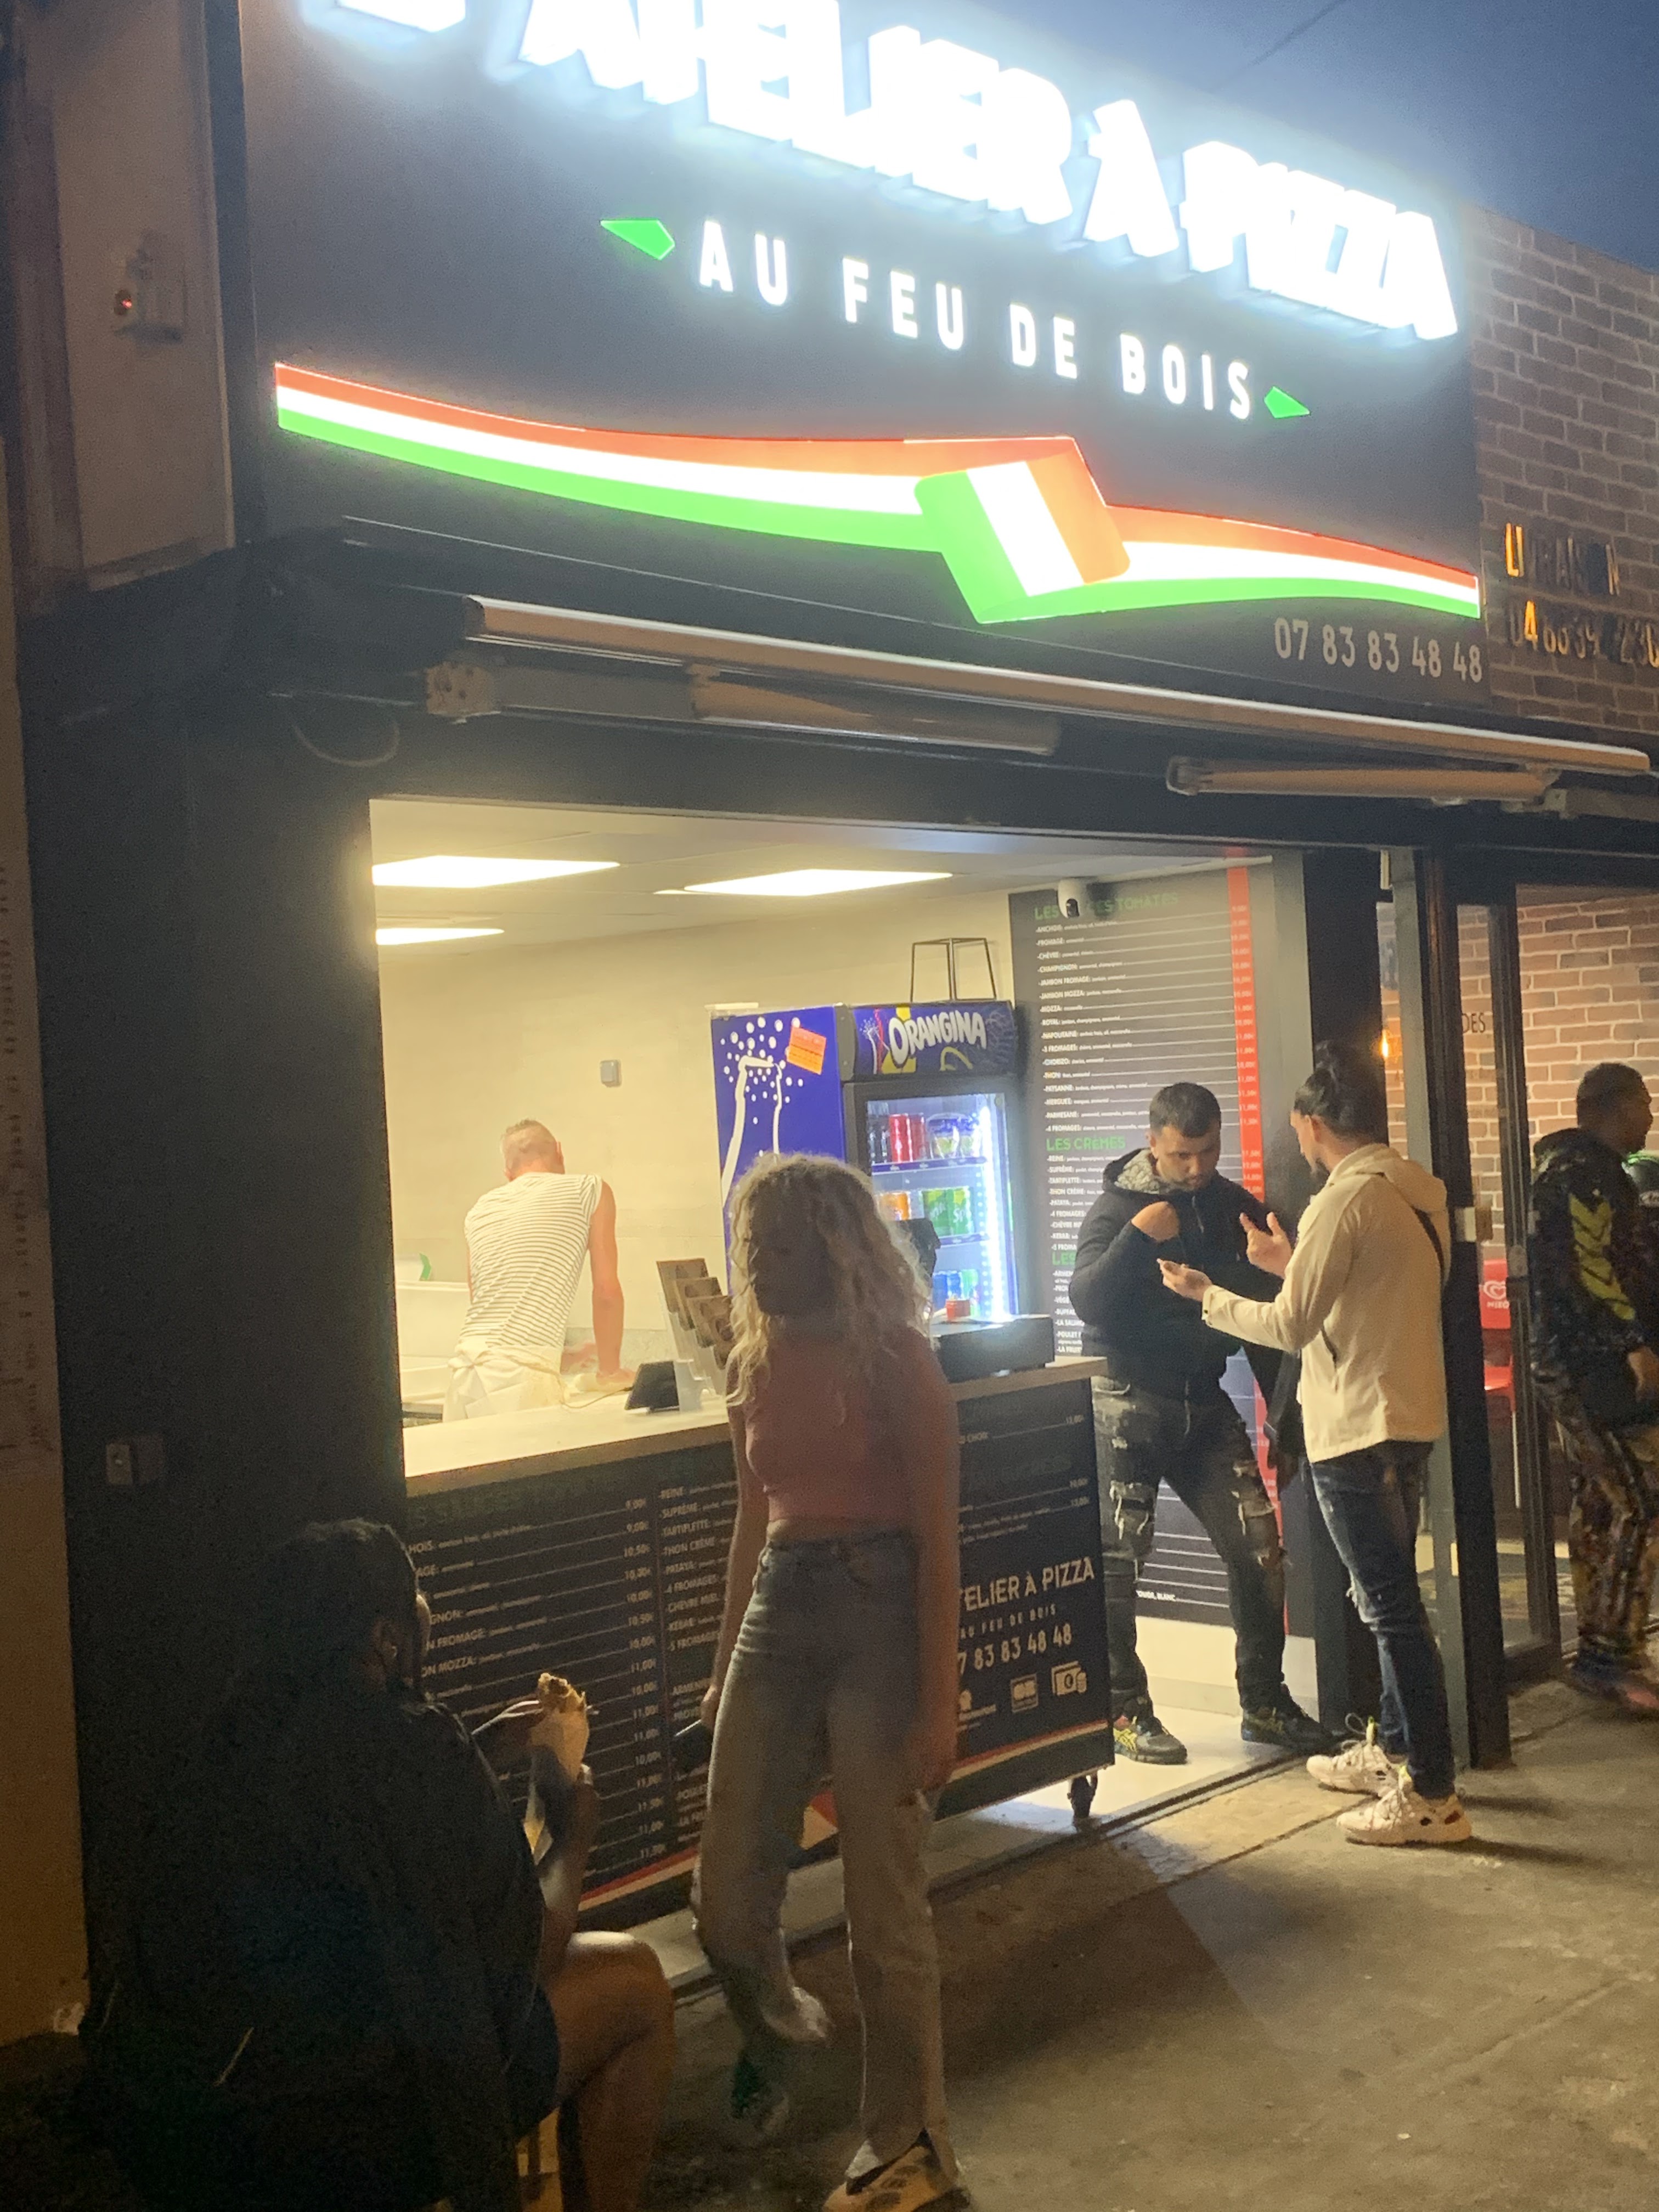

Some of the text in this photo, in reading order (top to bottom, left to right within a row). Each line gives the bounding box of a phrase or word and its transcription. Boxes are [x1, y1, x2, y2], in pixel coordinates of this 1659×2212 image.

[1180, 141, 1458, 340] PIZZA
[699, 219, 1251, 420] AU FEU DE BOIS
[1274, 617, 1482, 683] 07 83 83 48 48
[889, 1010, 987, 1065] ORANGINA
[1046, 1138, 1070, 1151] LES
[960, 1575, 1019, 1611] ELIER
[1042, 1556, 1094, 1591] PIZZA
[981, 1617, 1003, 1634] FEU
[1030, 1603, 1056, 1622] BOIS
[974, 1644, 995, 1671] 83
[1001, 1636, 1022, 1663] 83
[1027, 1629, 1047, 1654] 48
[1052, 1622, 1072, 1647] 48
